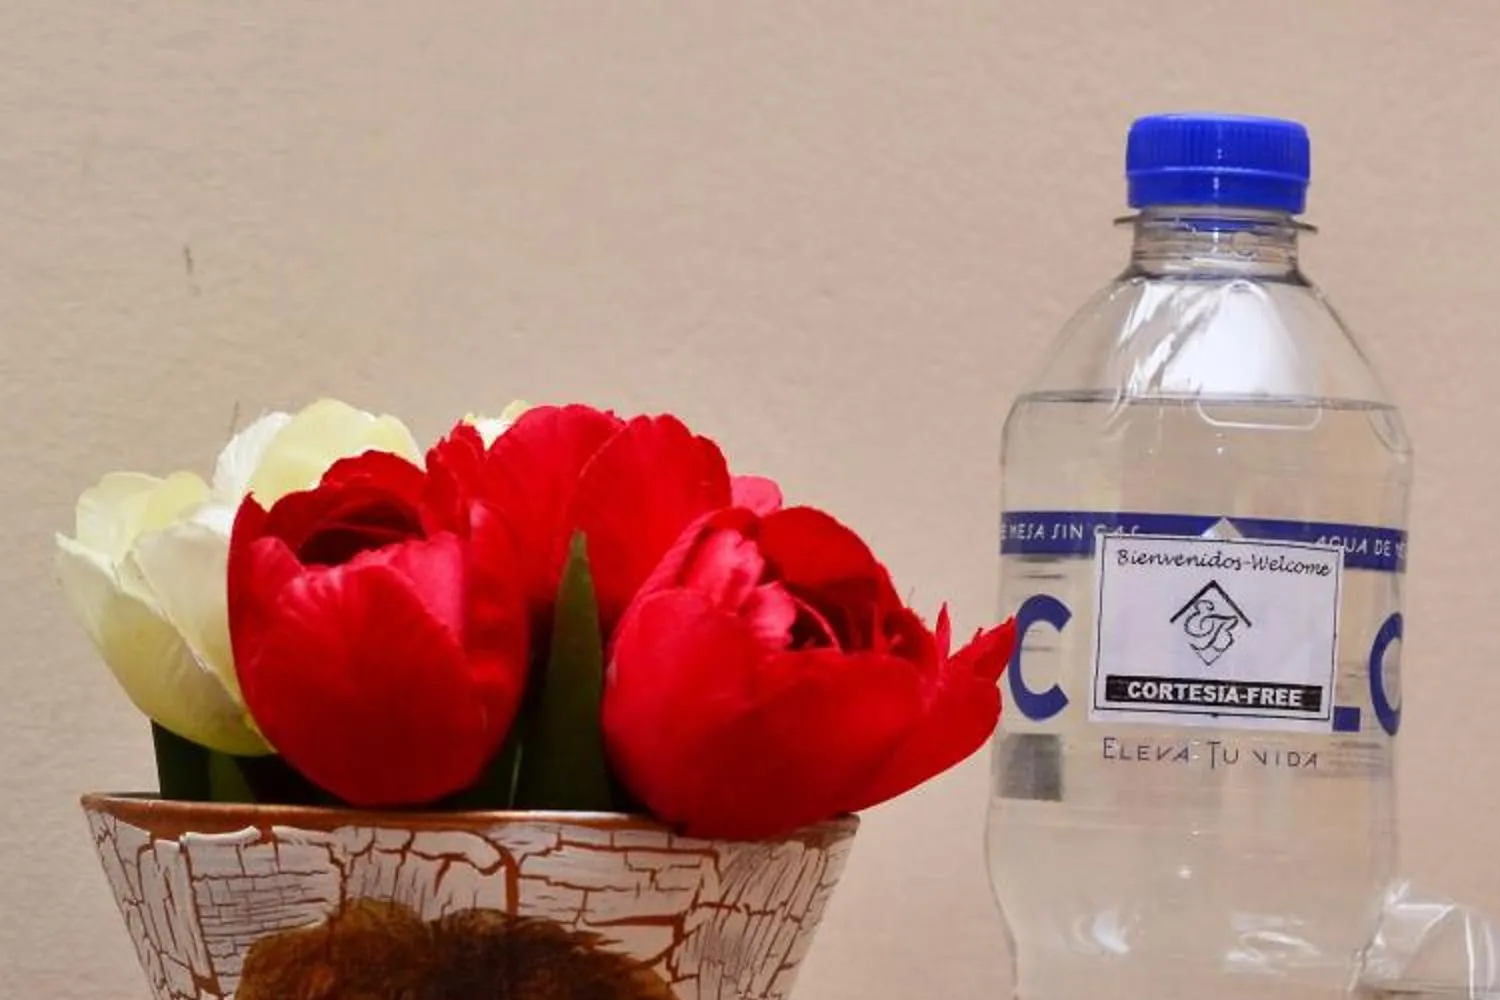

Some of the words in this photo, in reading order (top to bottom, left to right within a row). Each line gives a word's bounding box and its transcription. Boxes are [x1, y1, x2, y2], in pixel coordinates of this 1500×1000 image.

[1051, 523, 1084, 540] SIN
[1374, 539, 1392, 557] DE
[1127, 680, 1302, 707] CORTESIA-FREE
